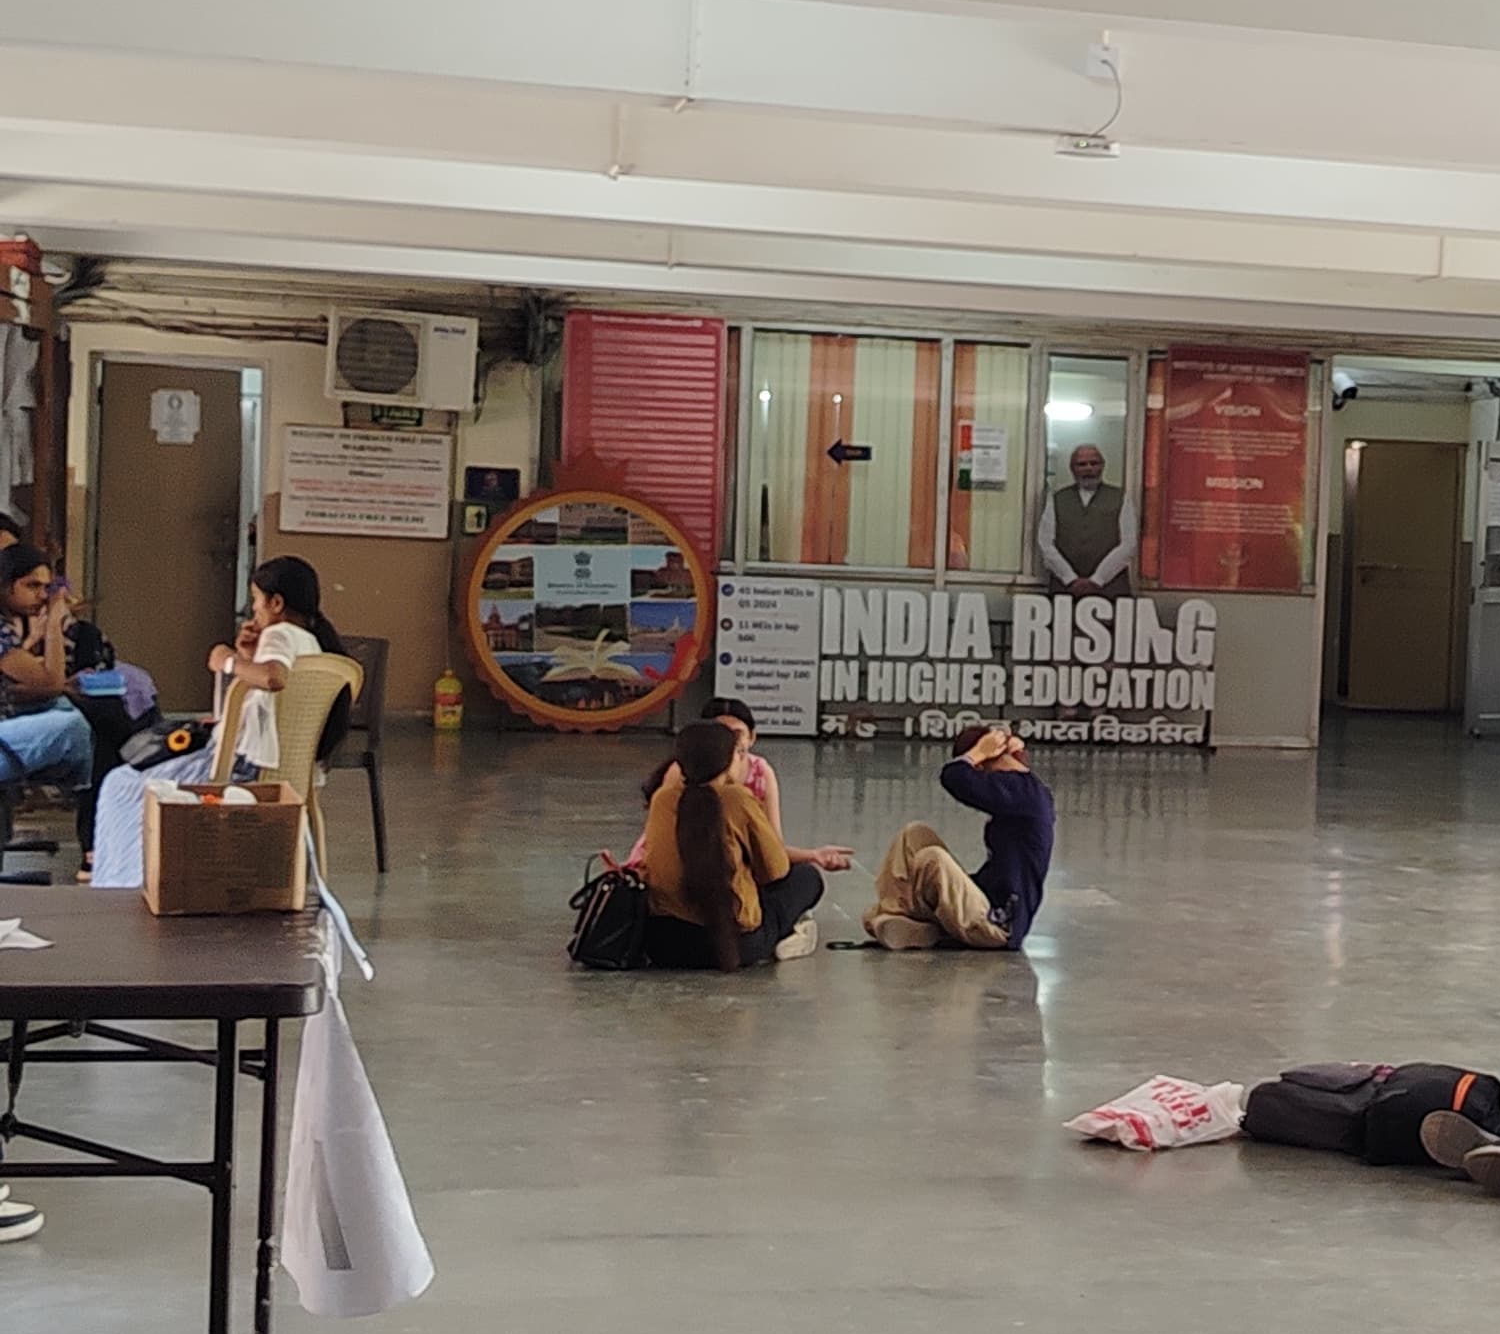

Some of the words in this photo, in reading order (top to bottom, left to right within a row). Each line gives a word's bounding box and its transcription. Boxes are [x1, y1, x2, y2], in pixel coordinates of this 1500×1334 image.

[1214, 405, 1261, 416] VISION
[1205, 476, 1264, 489] MISSION
[822, 587, 993, 659] INDIA
[1012, 593, 1217, 666] RISING
[820, 660, 859, 703] IN
[867, 661, 1007, 705] HIGHER
[1013, 666, 1215, 711] EDUCATION
[1018, 720, 1091, 740] भारत
[1093, 714, 1204, 743] विकसित
